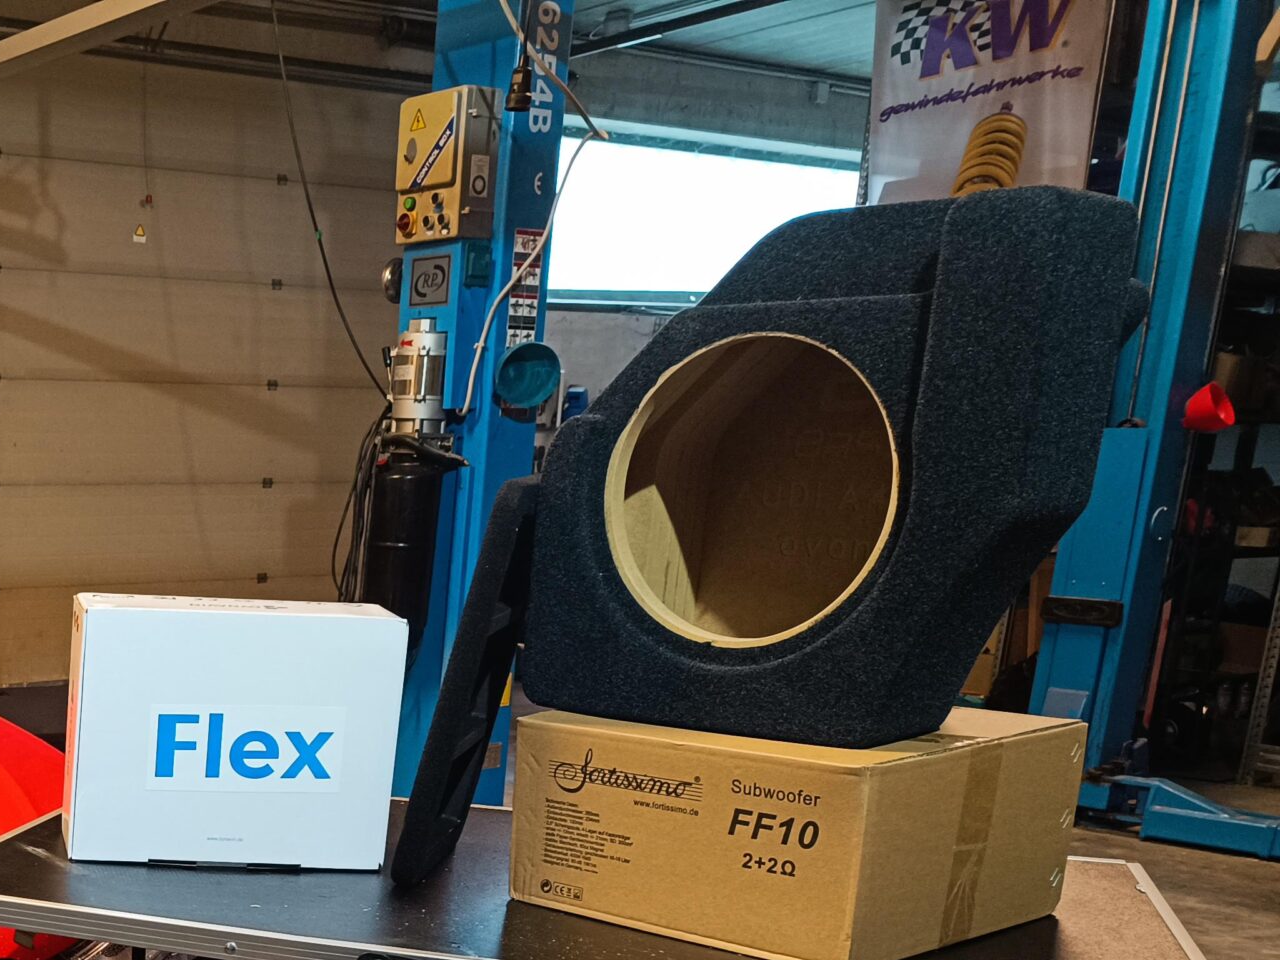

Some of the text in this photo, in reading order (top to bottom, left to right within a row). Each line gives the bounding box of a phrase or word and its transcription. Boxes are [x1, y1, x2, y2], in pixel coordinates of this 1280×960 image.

[528, 1, 561, 133] 6254B
[920, 0, 1074, 79] KW
[879, 65, 1084, 123] gewindefahrwerke
[417, 128, 451, 183] CONTROL BOX
[154, 713, 334, 779] Flex
[632, 799, 699, 817] www.fortissimo.de
[731, 779, 821, 806] Subwoofer
[728, 808, 819, 849] FF10
